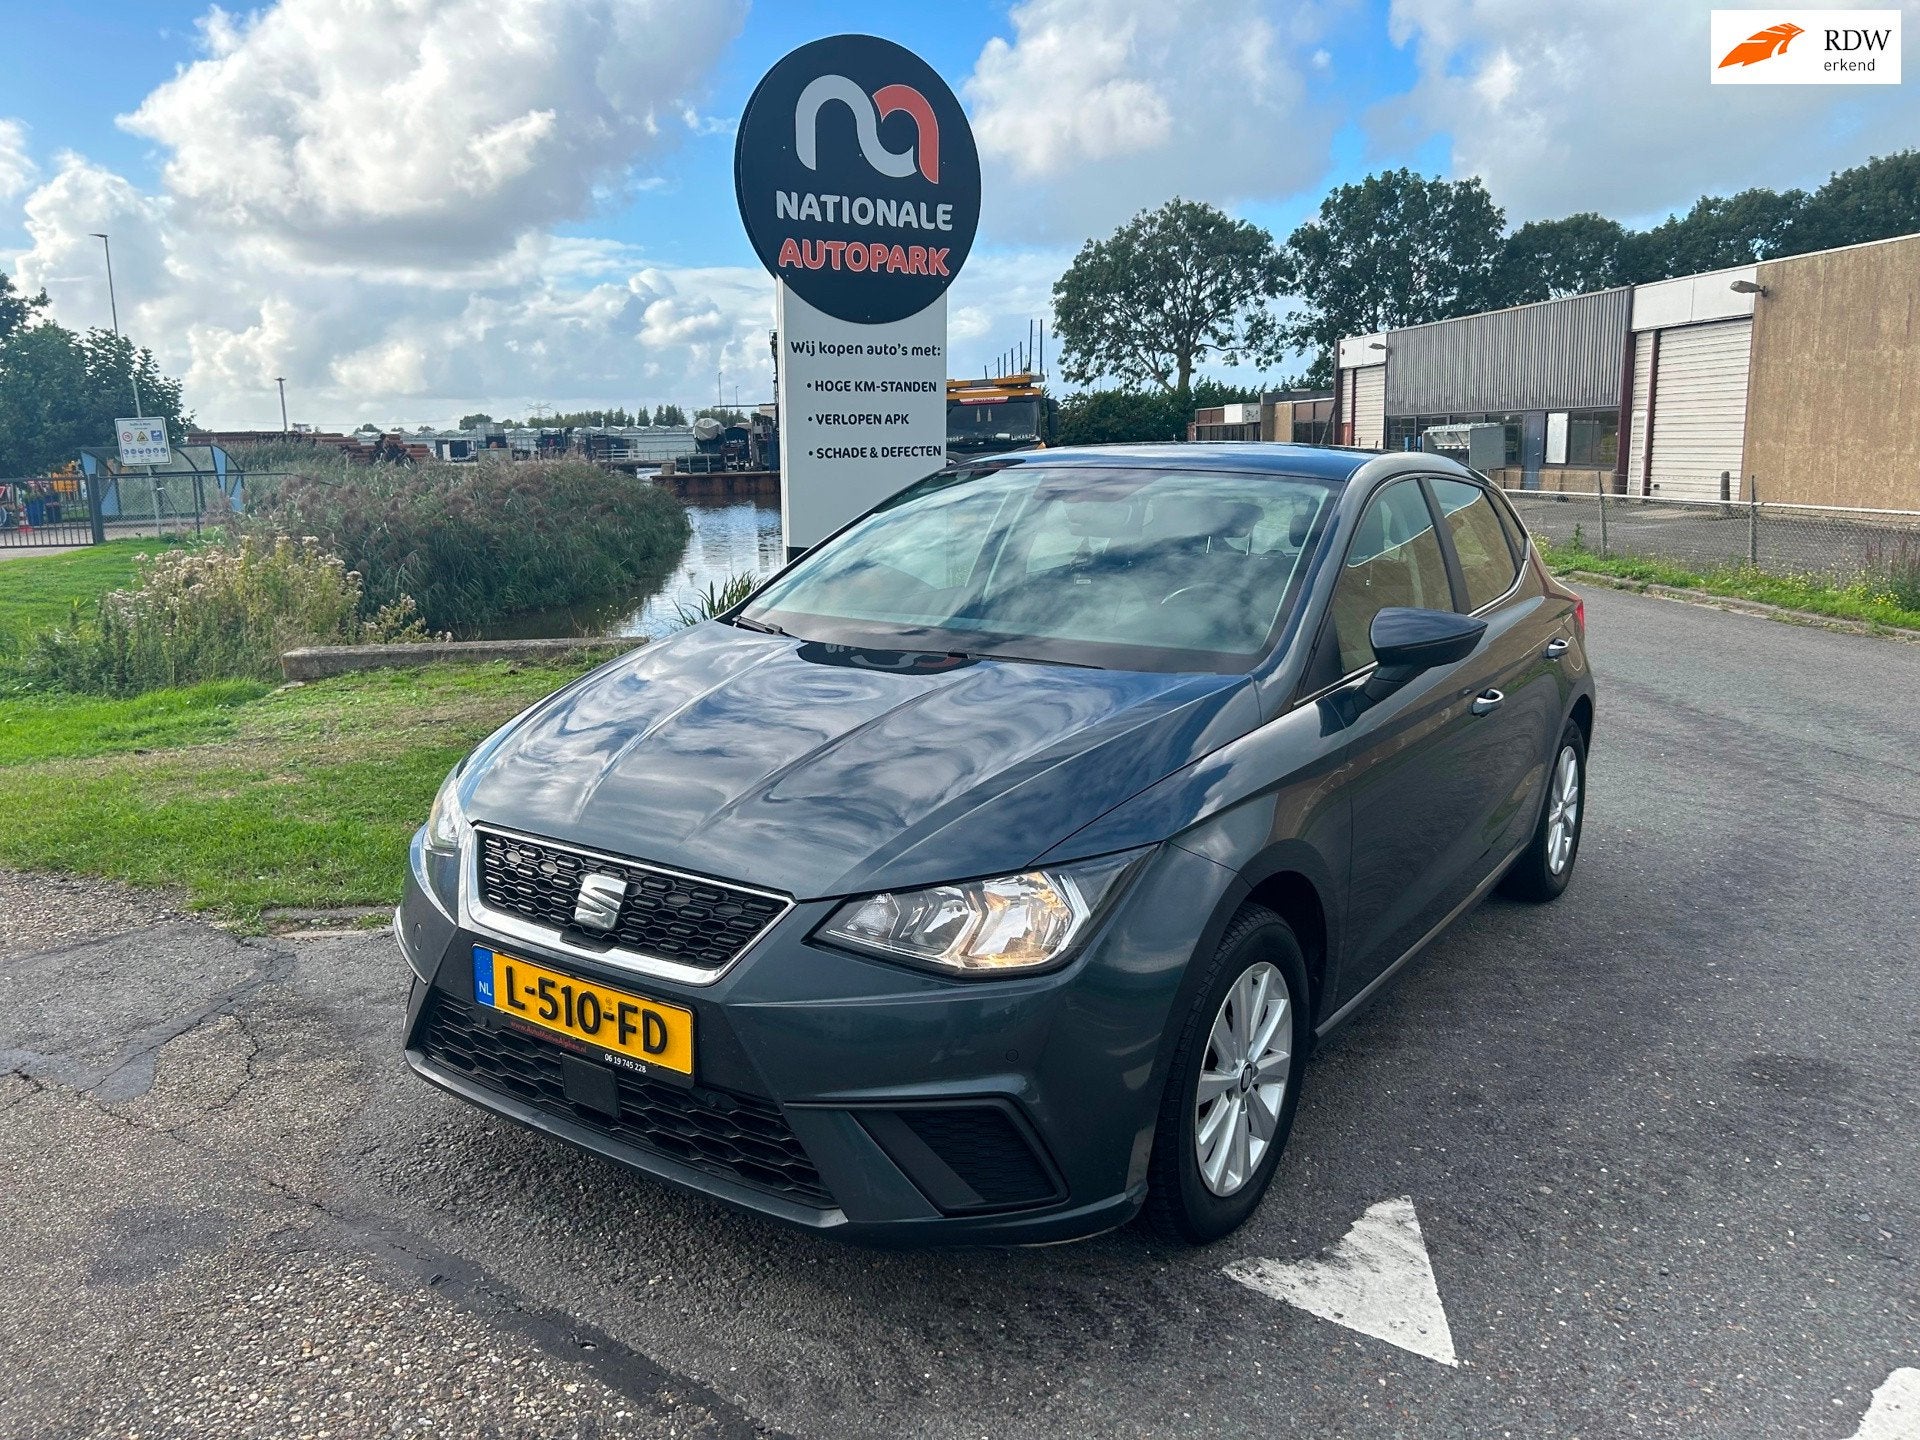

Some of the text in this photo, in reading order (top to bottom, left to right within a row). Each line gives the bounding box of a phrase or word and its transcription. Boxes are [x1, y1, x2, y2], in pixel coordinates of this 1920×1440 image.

[776, 190, 953, 231] NATIONALE
[778, 238, 950, 276] AUTOPARK
[790, 341, 941, 357] Wij kopen auto's met:
[815, 380, 937, 393] HOGE KM-STANDEN
[815, 413, 909, 425] VERLOPEN APK
[816, 445, 942, 459] SCHADE & DEFECTEN
[478, 980, 492, 996] NL
[505, 965, 668, 1055] L-510-FD
[604, 1053, 613, 1063] 06
[613, 1056, 621, 1065] 19
[622, 1059, 634, 1069] 745
